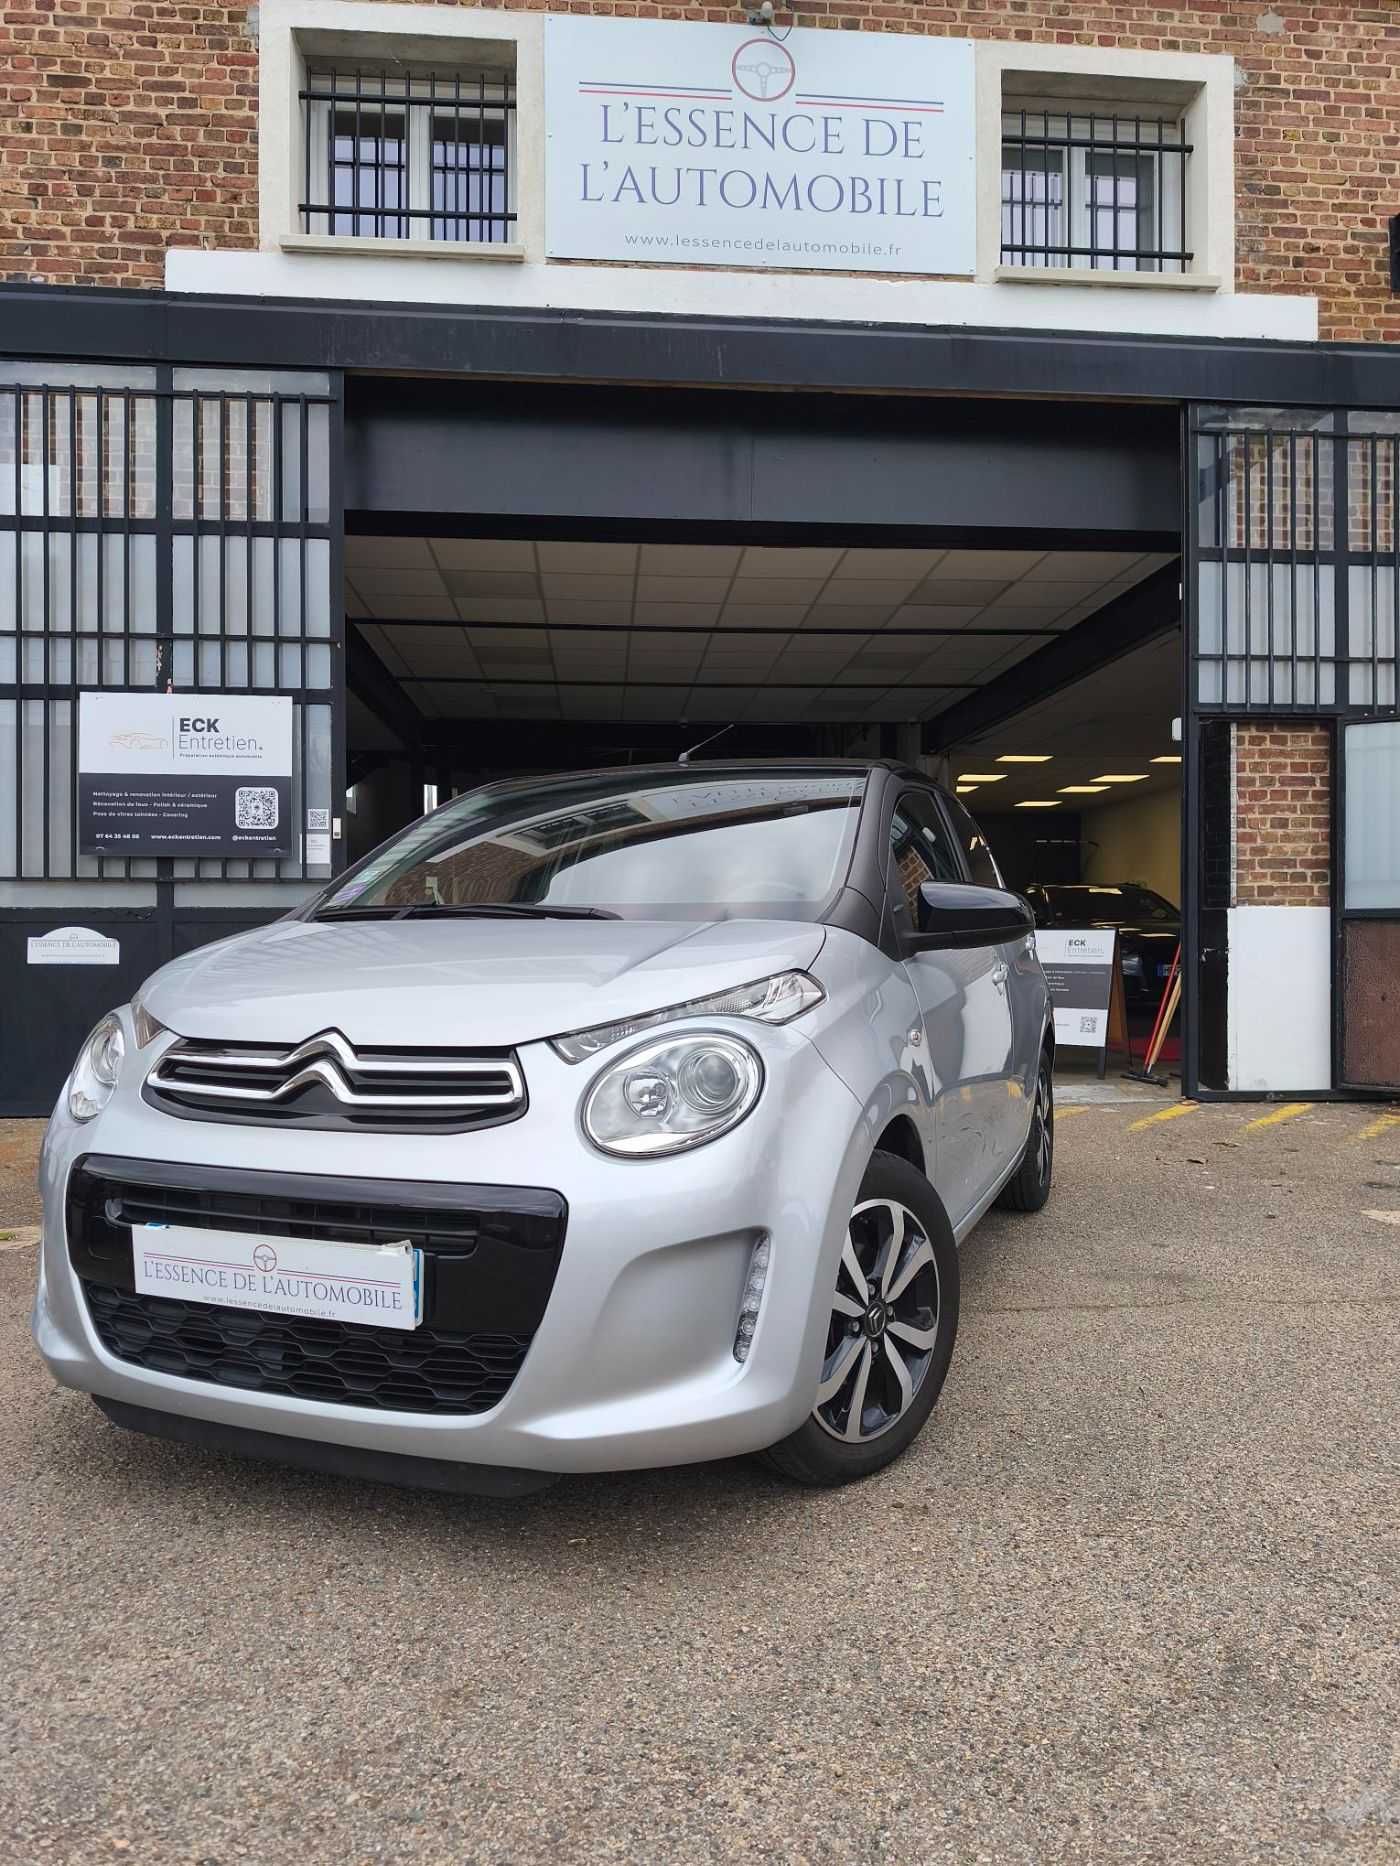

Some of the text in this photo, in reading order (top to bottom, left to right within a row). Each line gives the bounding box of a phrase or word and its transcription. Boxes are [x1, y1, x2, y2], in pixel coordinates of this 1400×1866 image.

[600, 101, 925, 159] L'ESSENCE DE
[580, 160, 944, 218] L'AUTOMOBILE
[624, 233, 903, 257] www.lessencedelautomobile.fr
[179, 717, 220, 733] ECK
[178, 734, 263, 751] Entretien.
[1068, 939, 1087, 947] ECK
[143, 1260, 403, 1311] L'ESSENCE DE L'AUTOMOBILE
